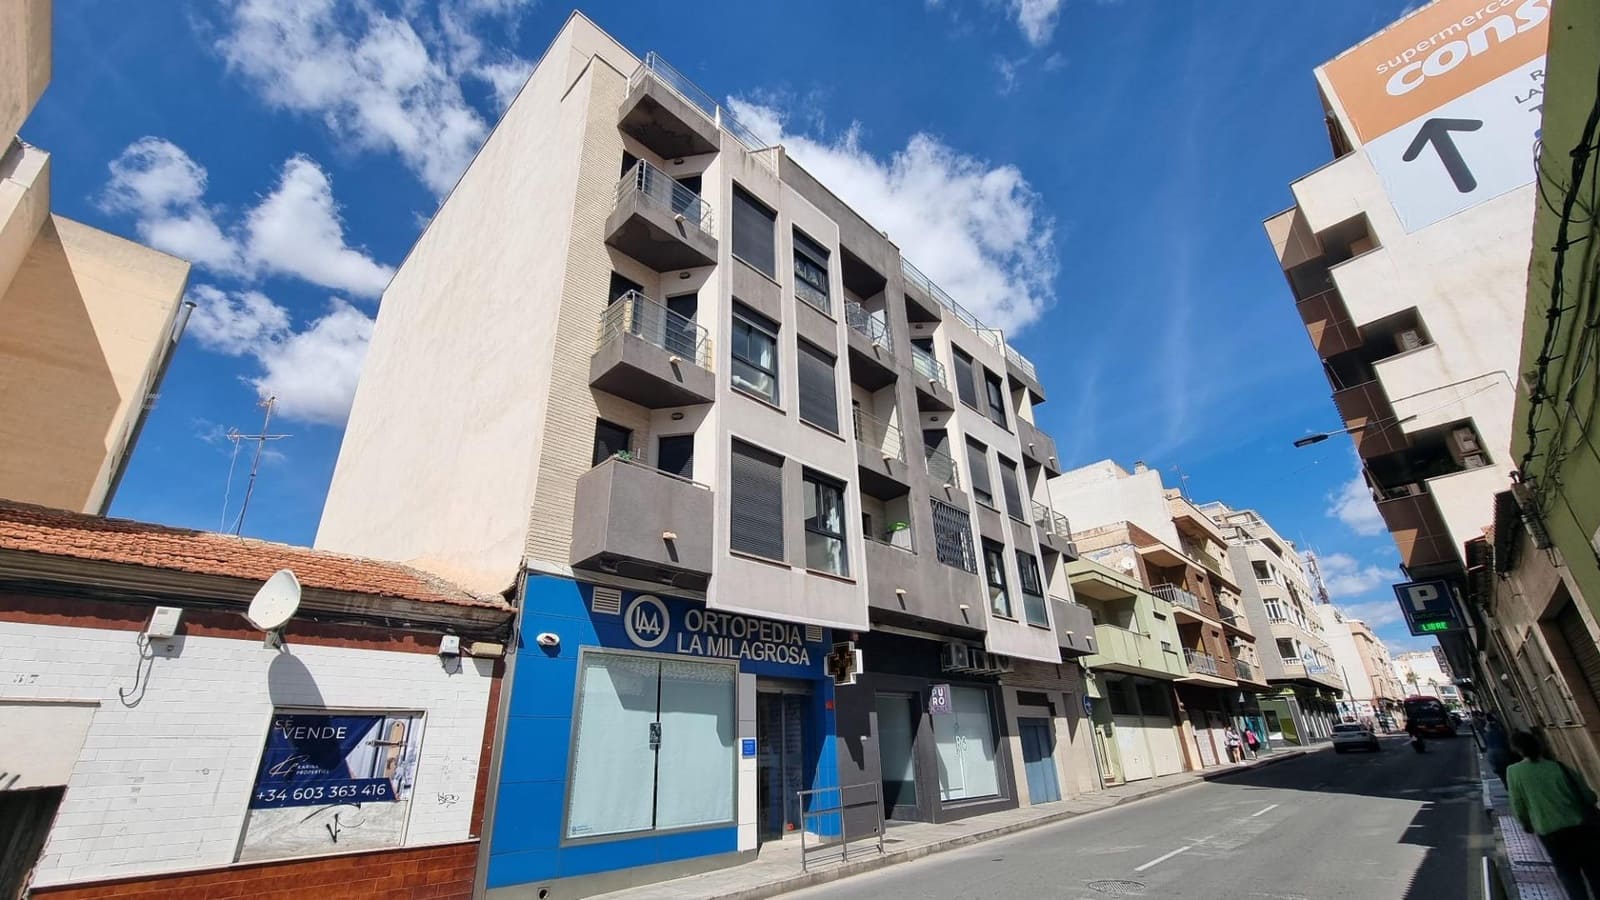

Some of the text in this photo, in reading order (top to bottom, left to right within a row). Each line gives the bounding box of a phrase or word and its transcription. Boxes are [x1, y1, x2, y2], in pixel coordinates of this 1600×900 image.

[1385, 0, 1551, 97] cons
[1407, 584, 1438, 611] P
[684, 609, 802, 645] ORTOPEDIA
[1421, 621, 1448, 631] LIBRE
[677, 632, 810, 666] LA MILAGROSA
[274, 719, 294, 731] SE
[281, 726, 347, 740] VENDE
[256, 783, 386, 802] +34 603 363 416
